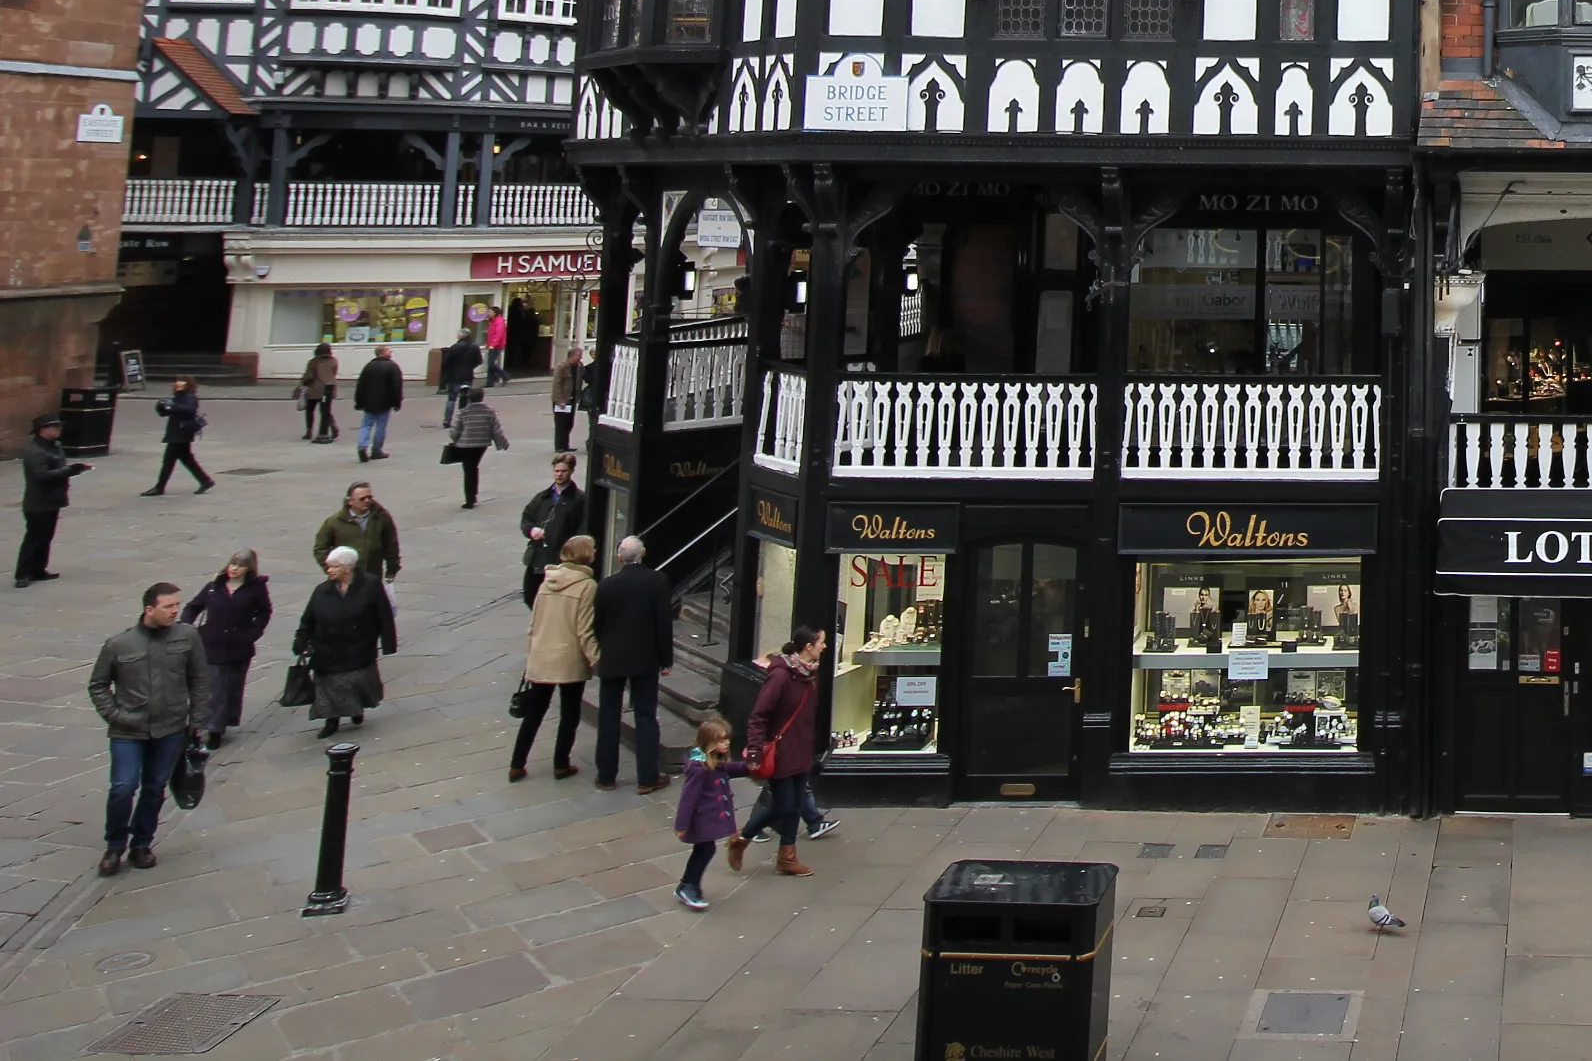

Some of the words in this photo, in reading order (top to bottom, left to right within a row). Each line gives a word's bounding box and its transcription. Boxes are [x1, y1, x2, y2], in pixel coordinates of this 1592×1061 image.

[827, 85, 887, 100] BRIDGE
[823, 106, 888, 122] STREET
[83, 119, 120, 128] EASTGATE
[86, 129, 114, 138] STREET
[946, 181, 969, 196] ZI
[975, 181, 1010, 196] MO
[1199, 194, 1238, 211] MO
[1245, 194, 1271, 211] ZI
[1280, 194, 1319, 211] MO
[496, 256, 512, 274] H
[517, 253, 602, 273] SAMUEL
[1202, 291, 1246, 307] Gabor
[756, 500, 792, 533] Waltons
[851, 514, 936, 539] Waltons
[1186, 511, 1309, 547] Waltons
[850, 554, 938, 587] SALE
[950, 962, 984, 975] Litter
[1026, 965, 1058, 976] recycle
[970, 1044, 1022, 1058] Cheshire
[1026, 1045, 1056, 1059] West
